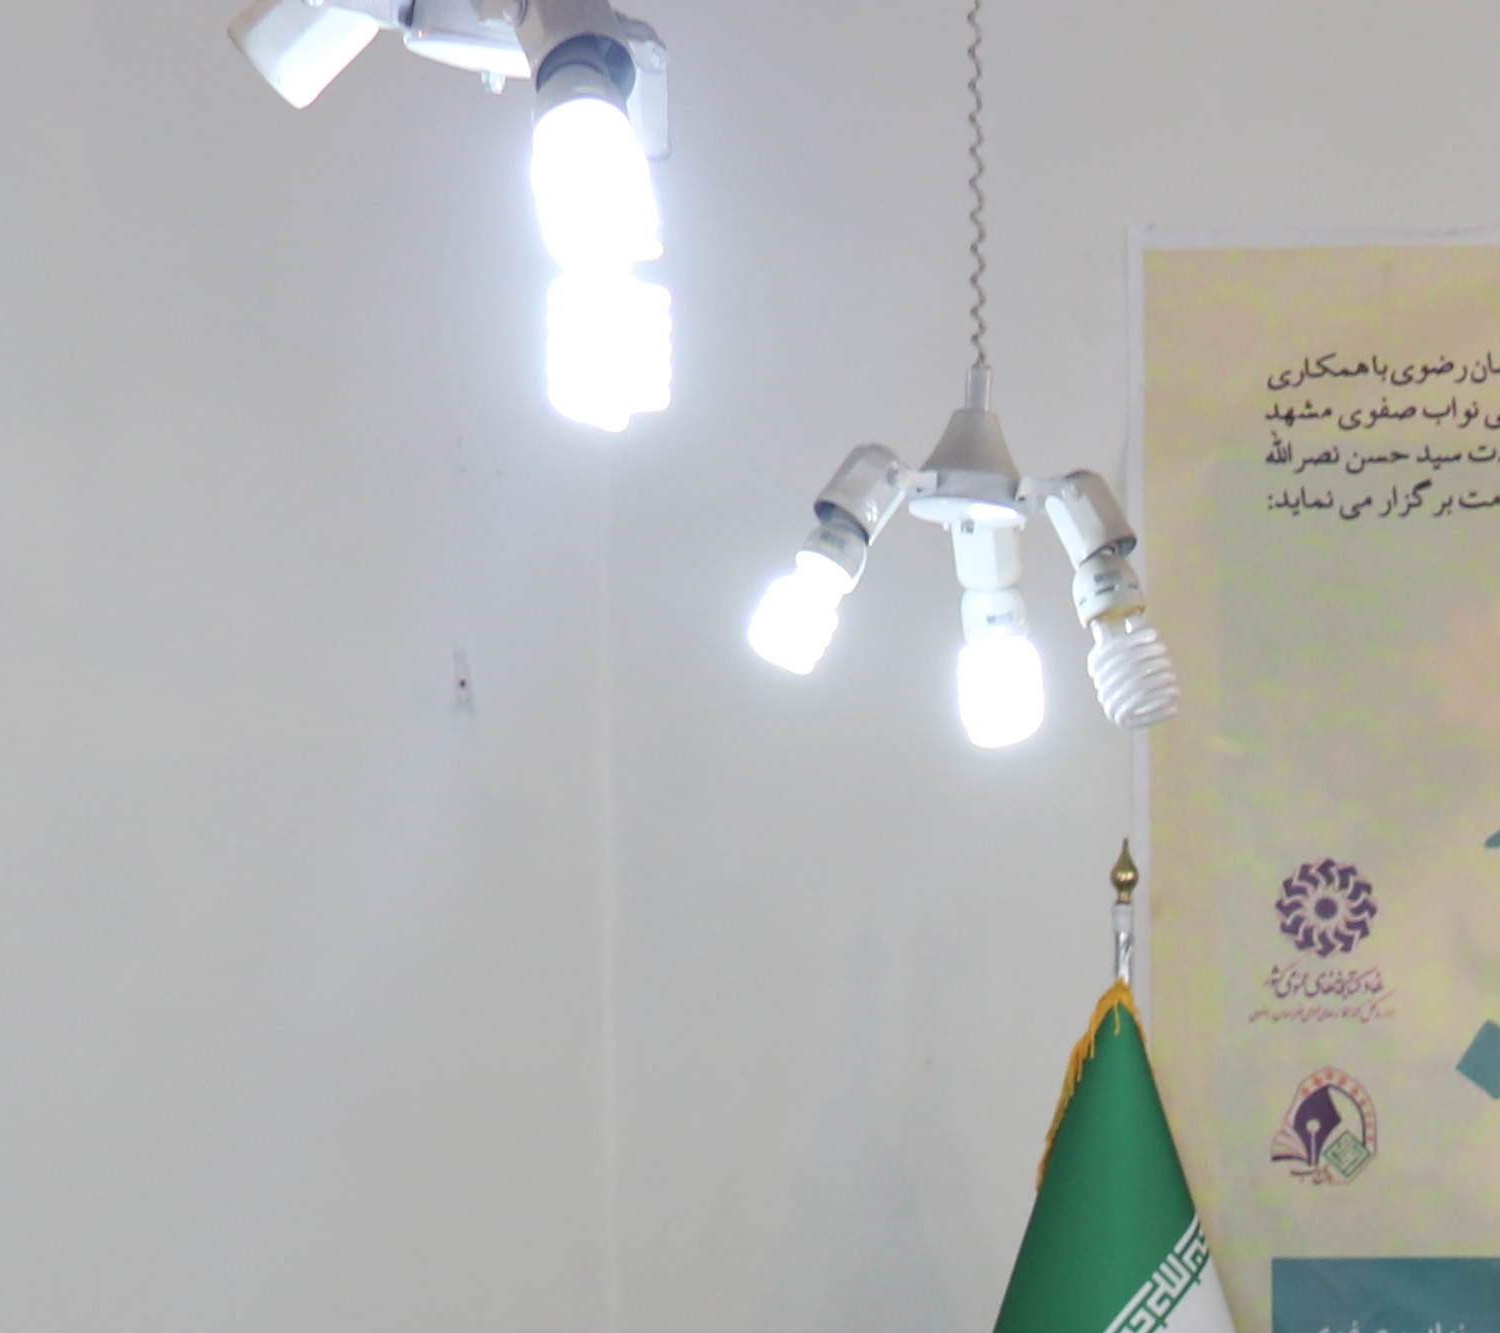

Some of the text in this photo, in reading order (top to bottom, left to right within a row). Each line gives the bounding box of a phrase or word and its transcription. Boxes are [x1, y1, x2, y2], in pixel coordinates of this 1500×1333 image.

[1390, 355, 1468, 387] رضوی
[1265, 399, 1332, 428] مشهد
[1338, 397, 1417, 432] صفوی
[1422, 396, 1479, 429] نواب
[1346, 450, 1409, 476] حسن
[1417, 445, 1462, 471] سید
